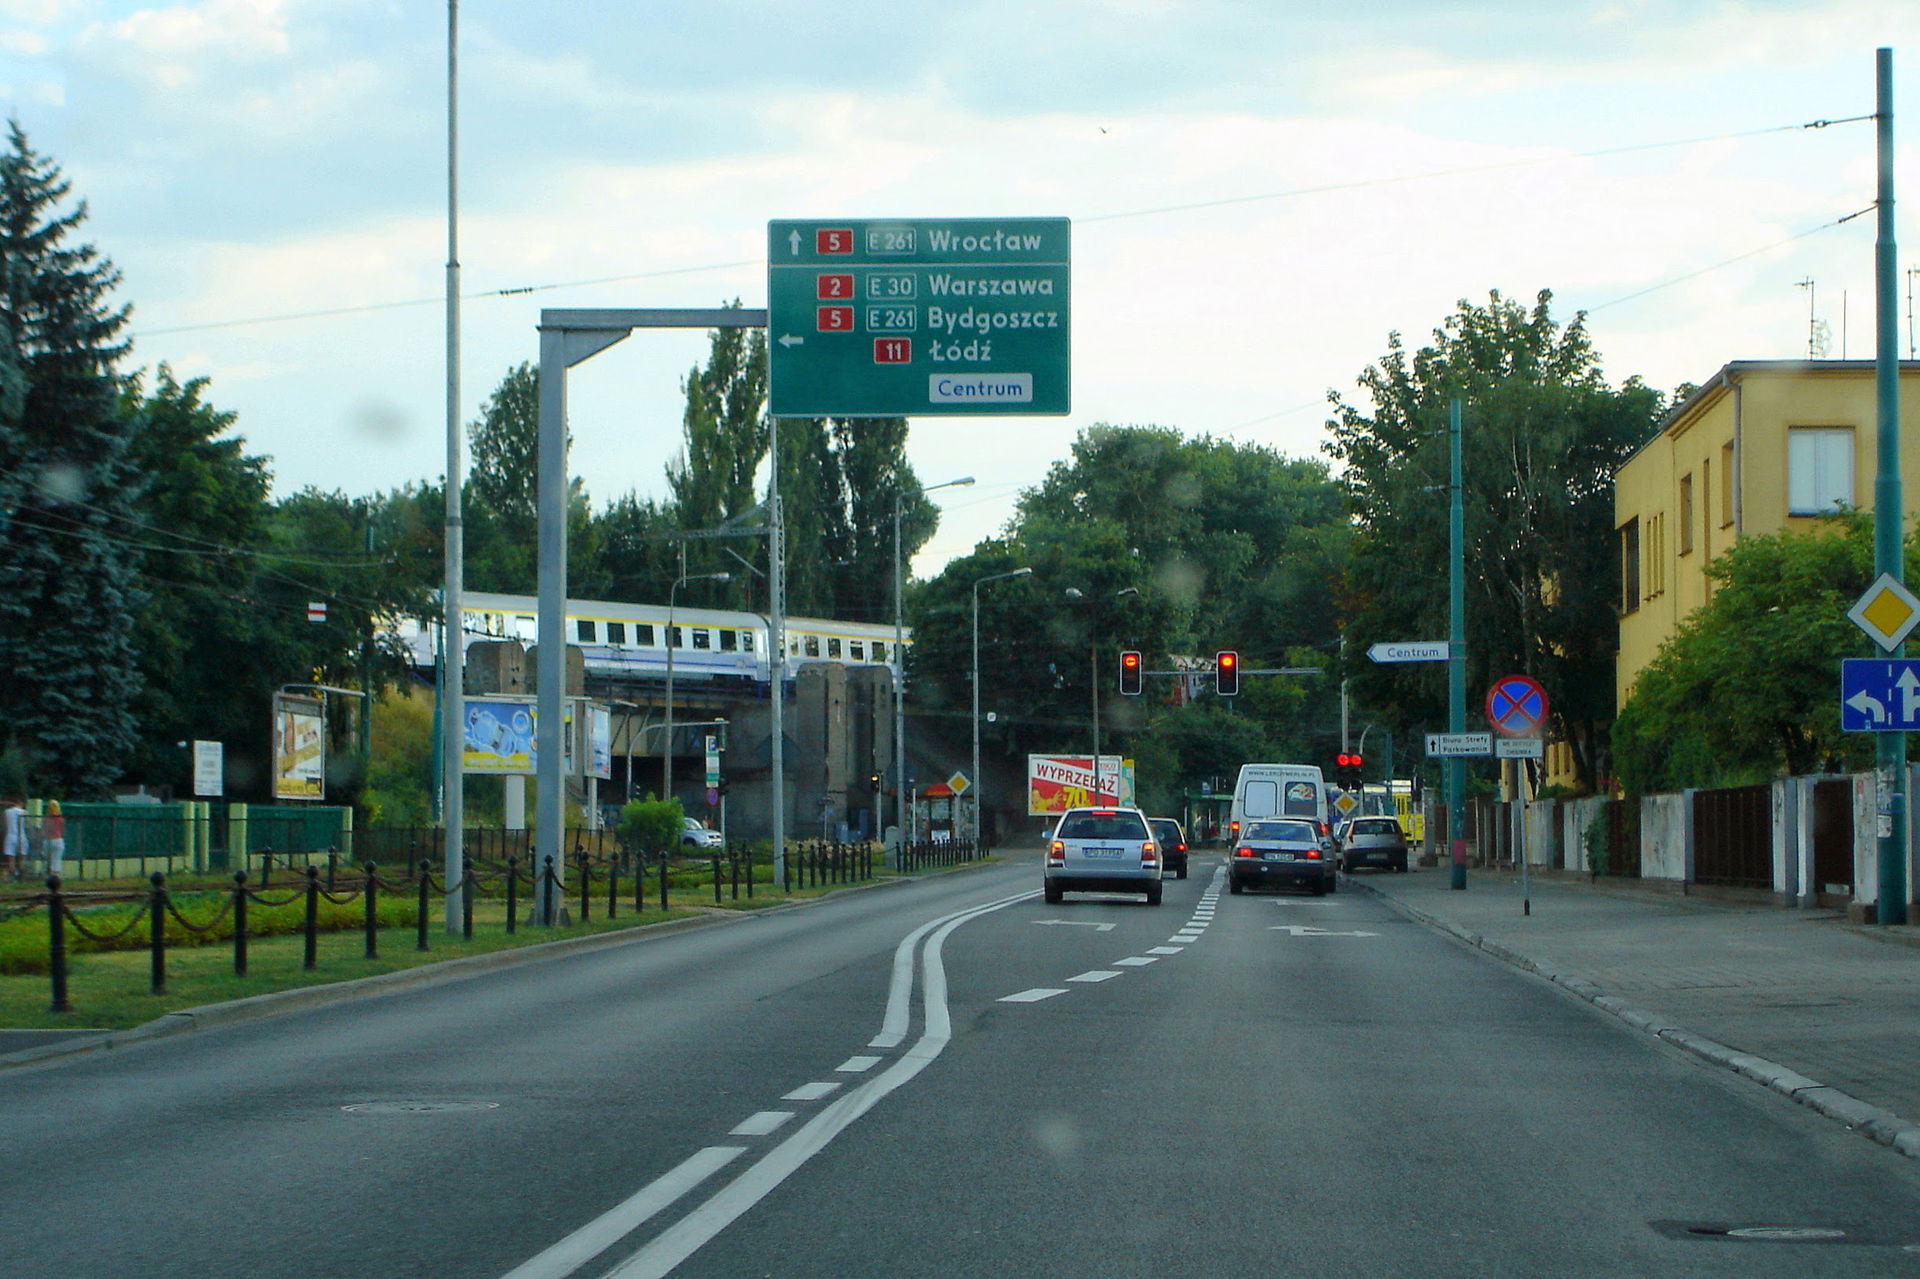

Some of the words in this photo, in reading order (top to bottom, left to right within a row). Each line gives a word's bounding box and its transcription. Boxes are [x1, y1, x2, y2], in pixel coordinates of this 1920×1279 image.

[829, 233, 840, 251] 5
[869, 233, 878, 249] E
[884, 232, 914, 250] 261
[929, 229, 1042, 252] Wrocław
[830, 278, 841, 297] 2
[871, 278, 880, 295] E
[888, 277, 912, 295] 30
[929, 274, 1053, 297] Warszawa
[830, 310, 841, 328] 5
[870, 310, 879, 327] E
[885, 309, 914, 327] 261
[928, 306, 1058, 334] Bydgoszcz
[886, 343, 902, 360] 11
[929, 339, 991, 362] Łódź
[938, 379, 1022, 397] Centrum
[1387, 647, 1439, 658] Centrum
